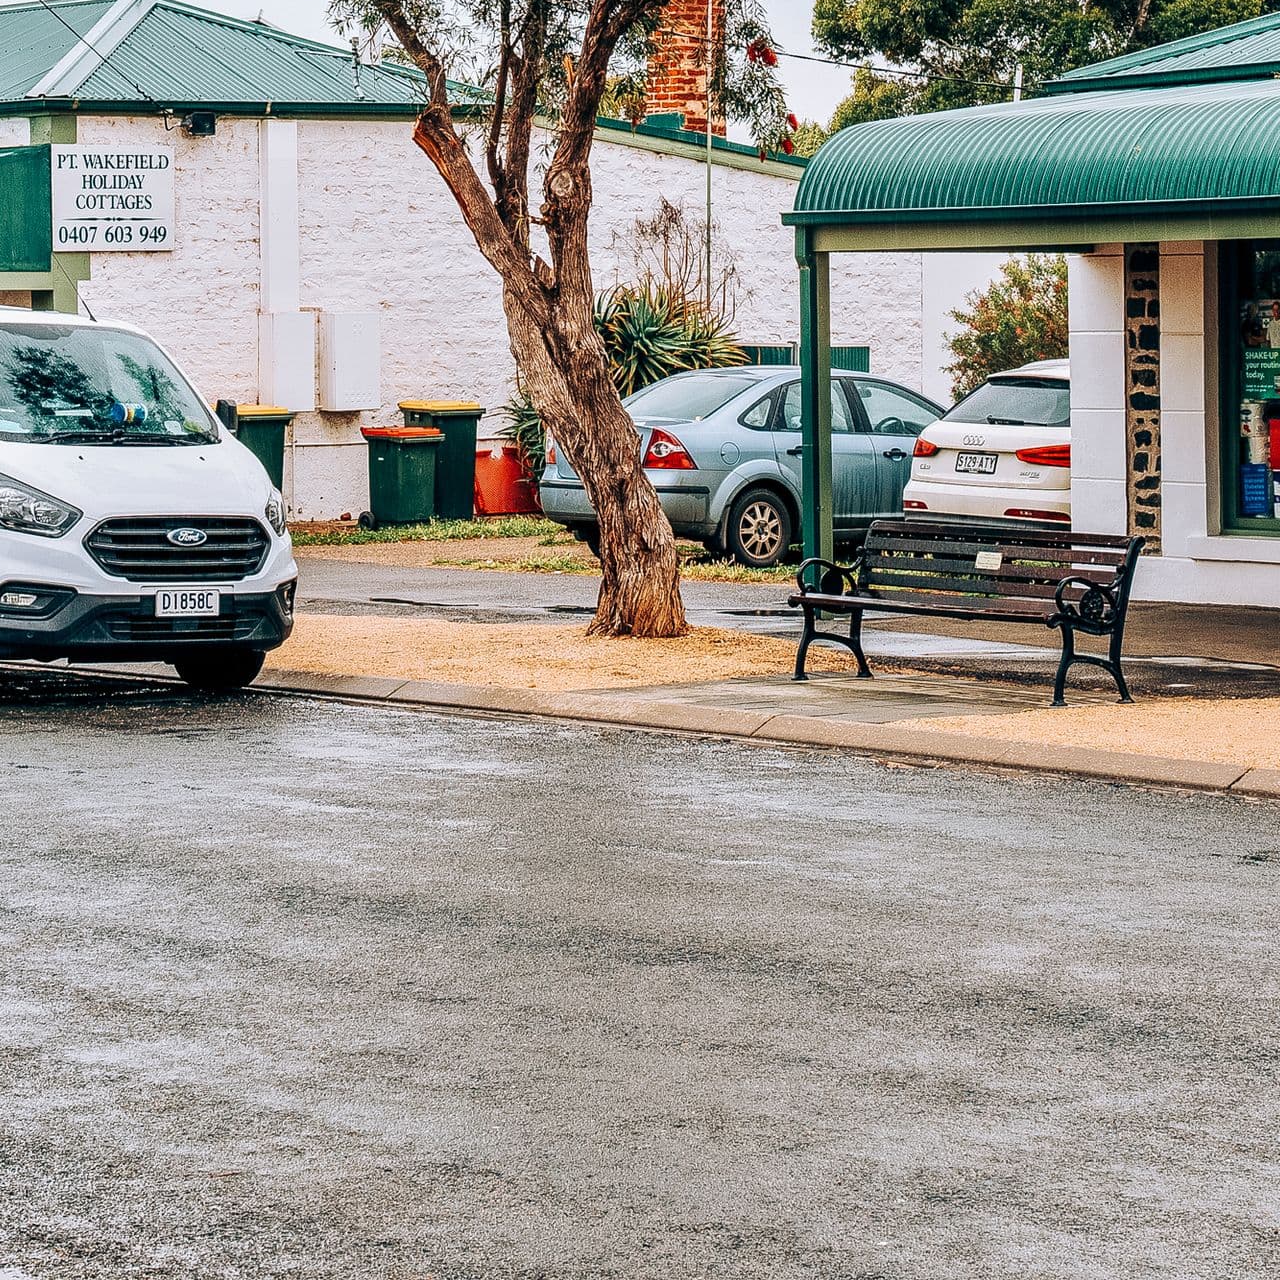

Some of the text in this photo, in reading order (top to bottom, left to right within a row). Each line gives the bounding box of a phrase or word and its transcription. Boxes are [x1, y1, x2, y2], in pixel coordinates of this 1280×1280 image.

[57, 154, 169, 169] PT. WAKEFIELD
[82, 174, 145, 189] HOLIDAY
[76, 194, 152, 209] COTTAGES
[59, 225, 167, 243] 0407 603 949
[1245, 352, 1279, 360] SHAKE-UP
[1246, 362, 1260, 370] your
[178, 531, 200, 542] Ford
